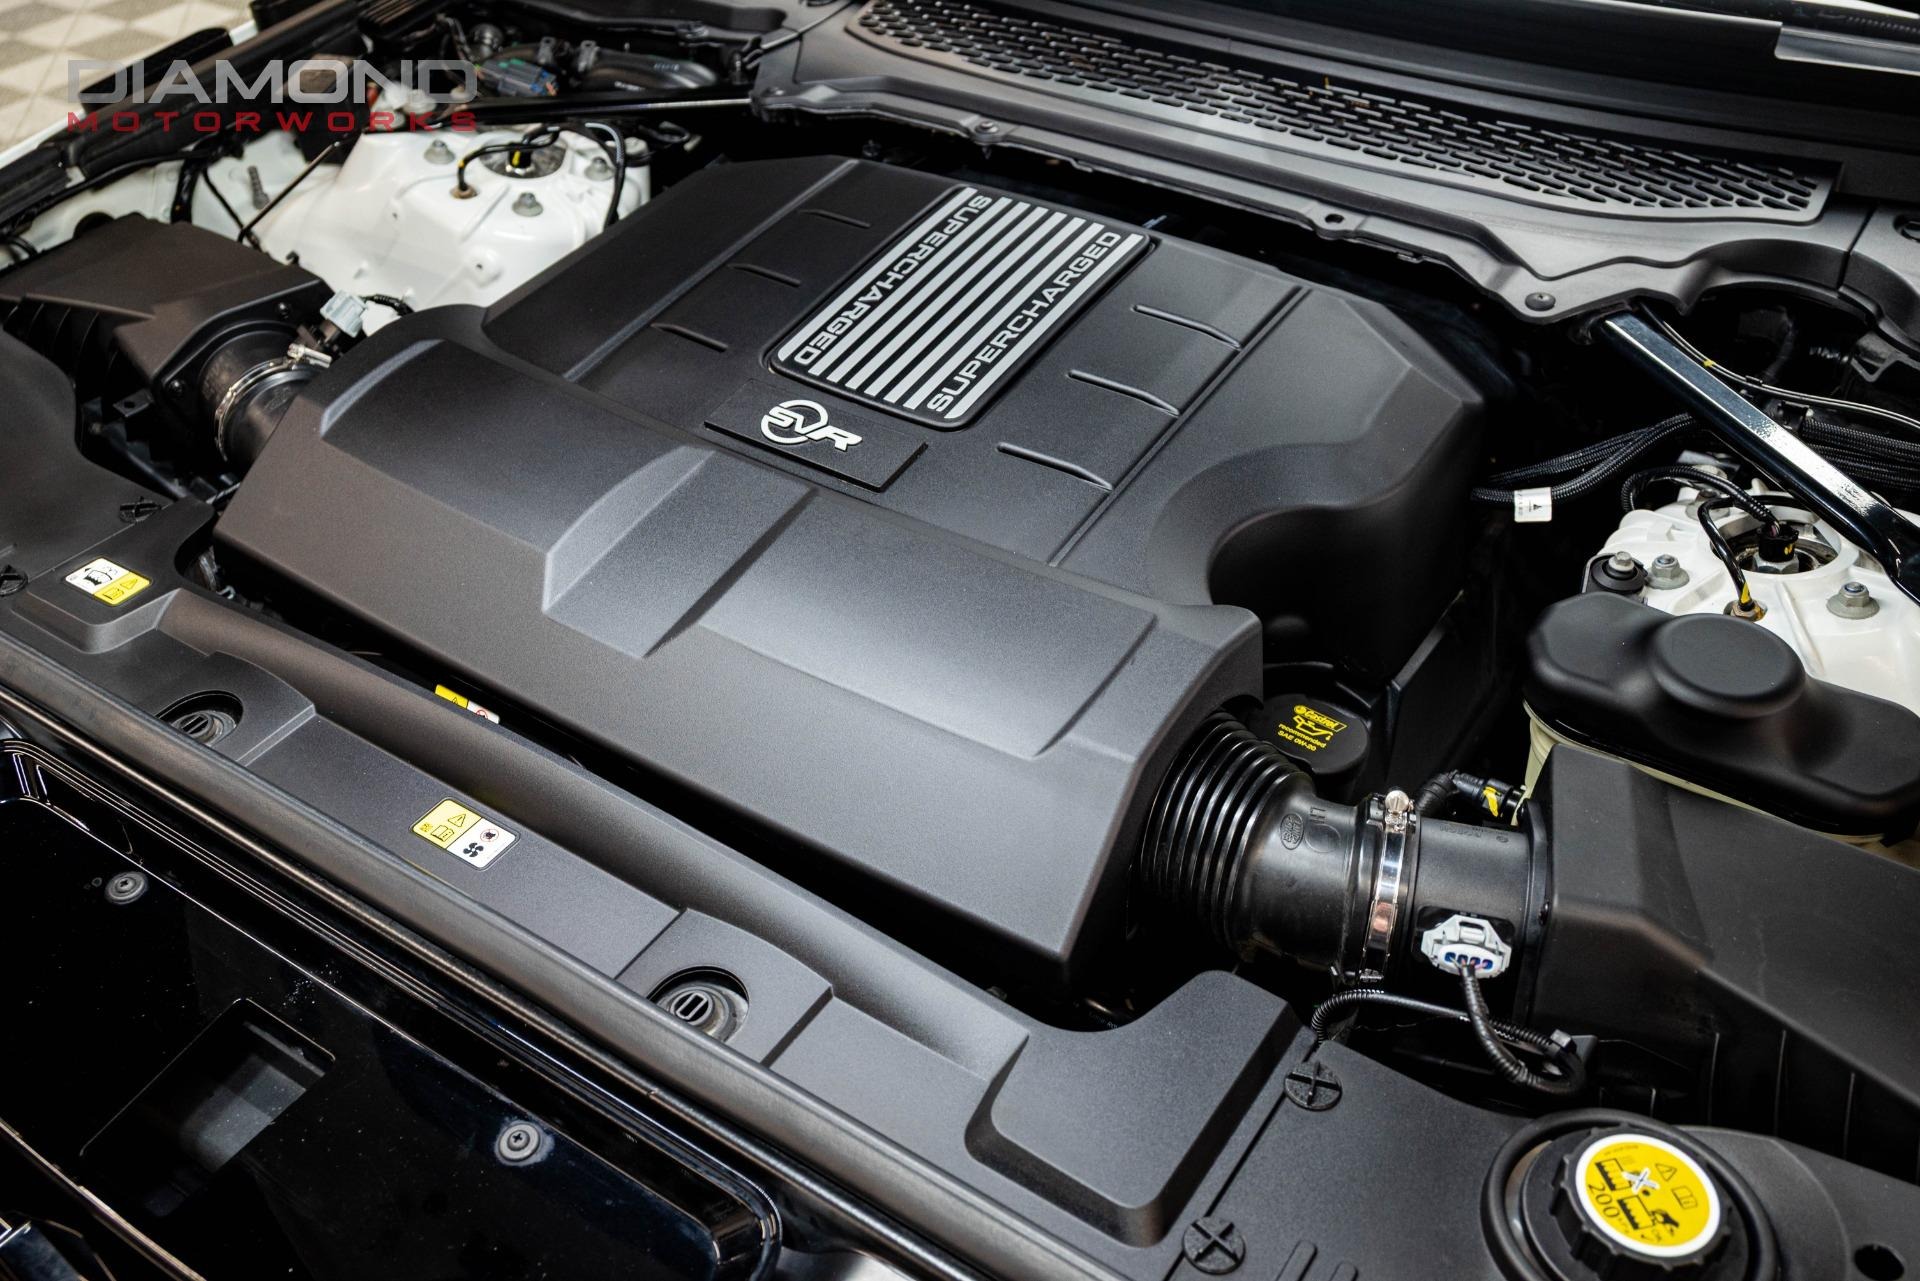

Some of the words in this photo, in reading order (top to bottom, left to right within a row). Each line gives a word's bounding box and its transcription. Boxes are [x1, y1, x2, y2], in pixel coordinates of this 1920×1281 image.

[795, 194, 993, 366] SUPERCHARGED
[927, 231, 1122, 412] SUPERCHARGED
[760, 399, 863, 452] SVR
[1278, 723, 1327, 749] recommended
[1587, 1182, 1621, 1220] 200
